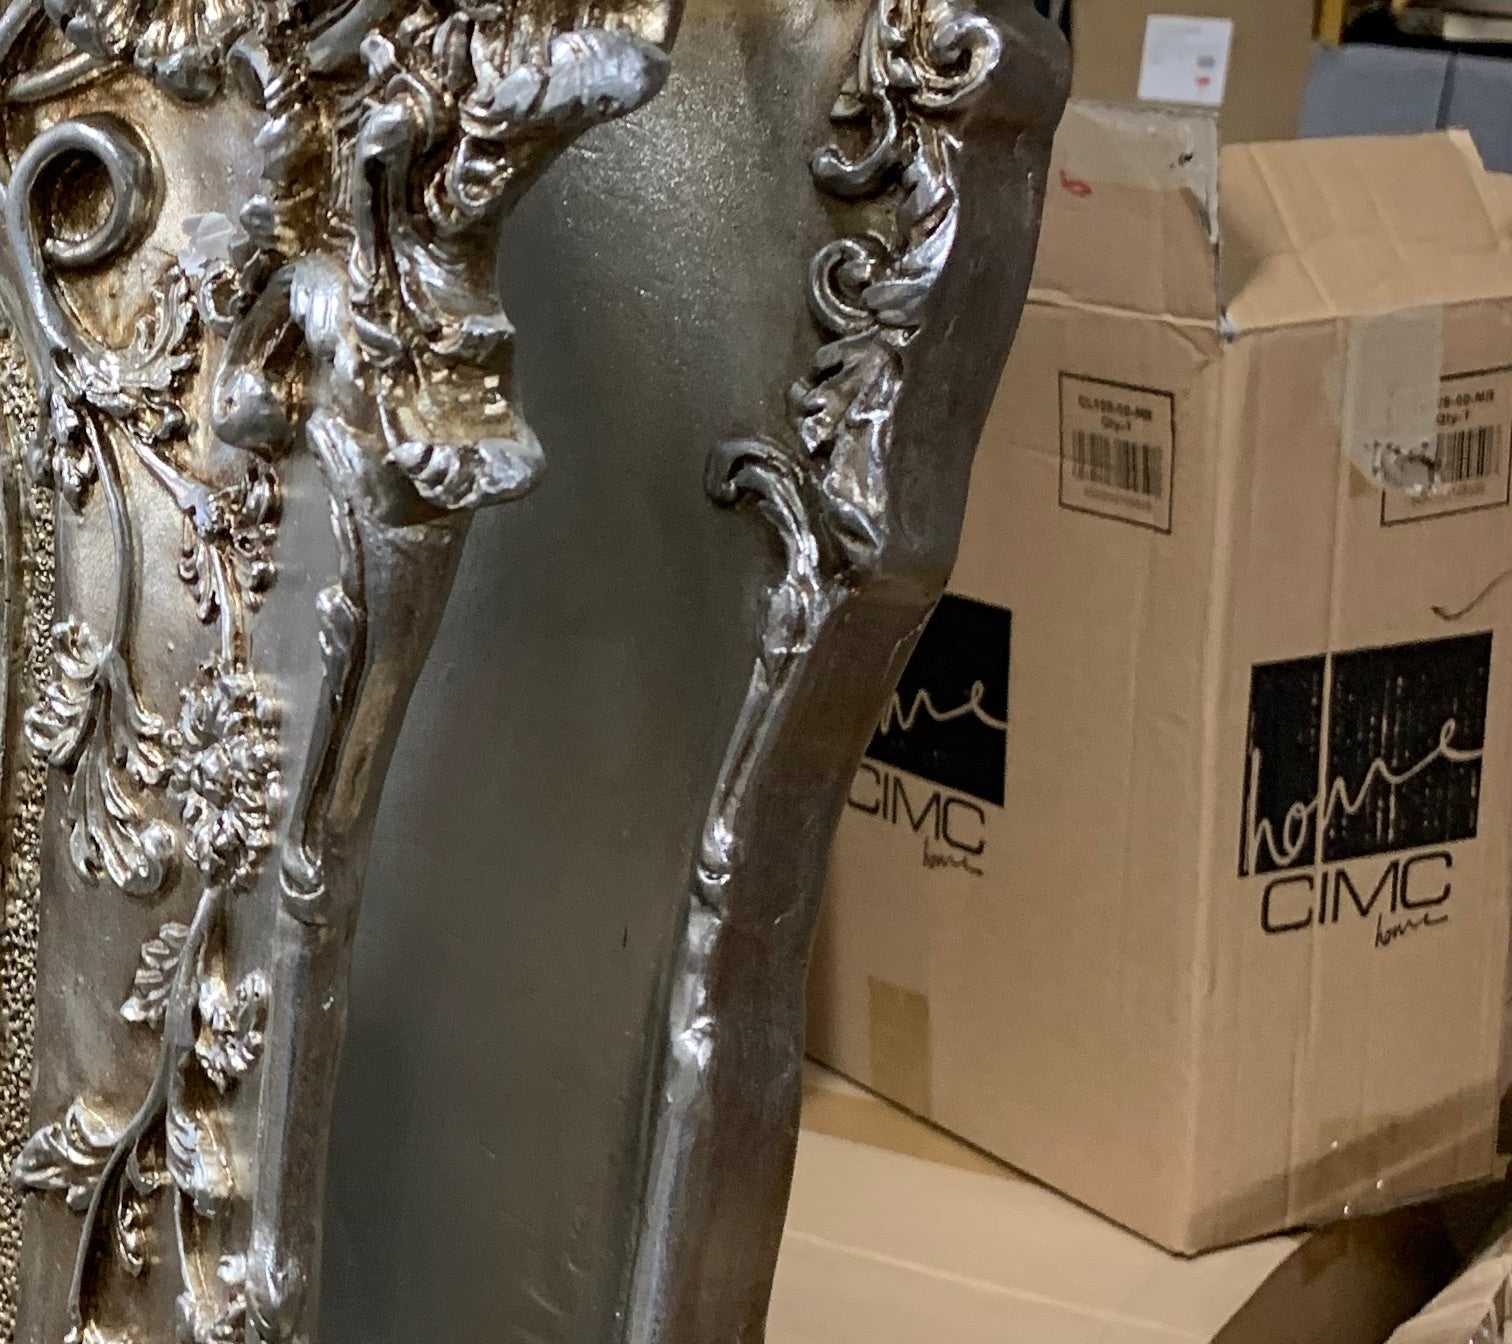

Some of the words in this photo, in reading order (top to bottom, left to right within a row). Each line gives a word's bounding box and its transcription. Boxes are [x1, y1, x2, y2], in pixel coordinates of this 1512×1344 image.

[846, 759, 986, 855] CIMC
[1246, 716, 1485, 875] home
[1260, 849, 1453, 935] CIMC
[1374, 911, 1449, 948] home
